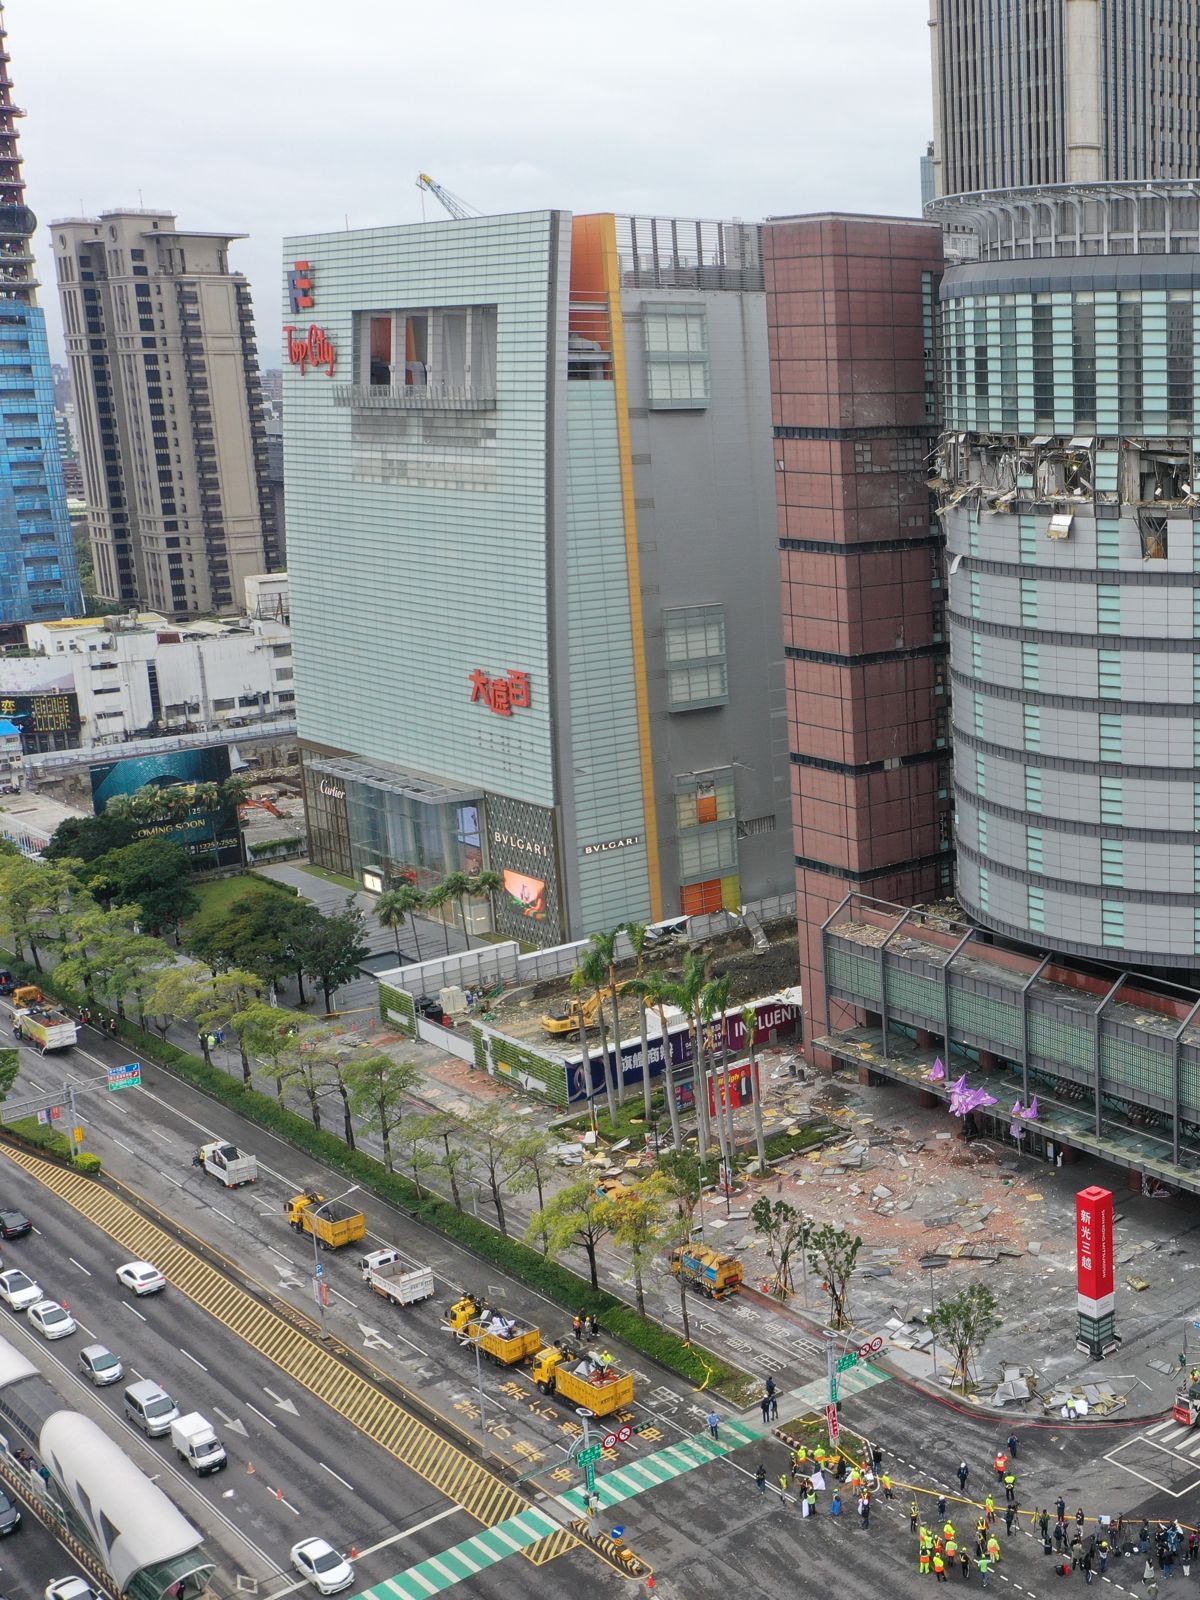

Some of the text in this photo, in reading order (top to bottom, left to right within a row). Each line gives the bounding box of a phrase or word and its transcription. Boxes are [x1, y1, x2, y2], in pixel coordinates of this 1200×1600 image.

[282, 324, 334, 377] Top City
[469, 668, 531, 717] 大遠百
[321, 779, 345, 799] Cartier
[175, 819, 206, 829] SOON
[494, 831, 547, 857] BVLGARI
[585, 837, 639, 854] BVLGARI
[1080, 1209, 1093, 1271] 新光三越
